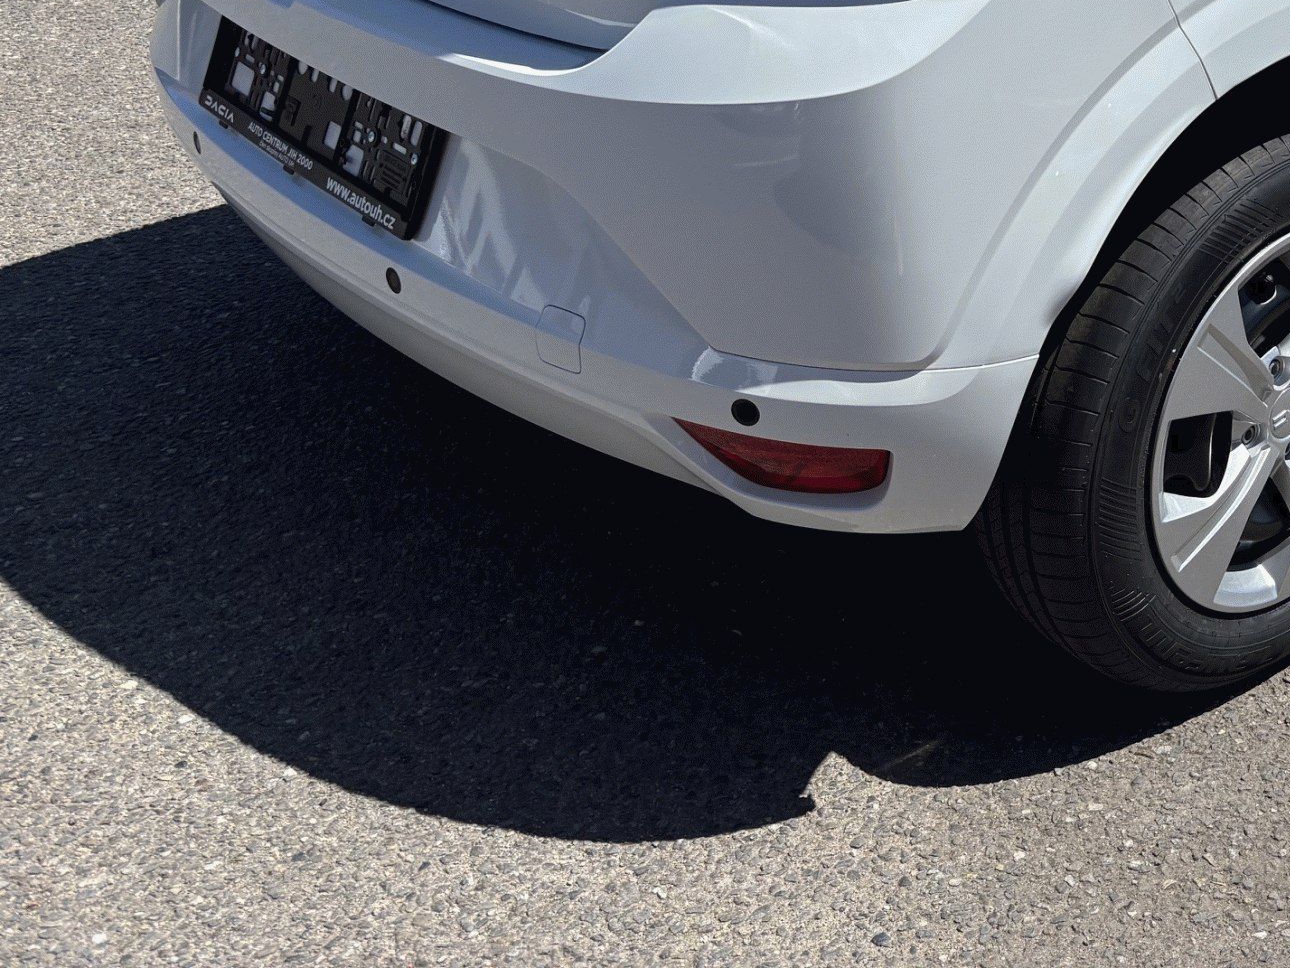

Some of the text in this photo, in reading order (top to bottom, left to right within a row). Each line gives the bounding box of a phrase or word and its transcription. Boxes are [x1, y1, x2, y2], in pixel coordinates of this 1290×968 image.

[204, 95, 234, 123] DACIA
[248, 121, 263, 137] AUTO
[262, 131, 288, 154] CENTRUM
[296, 153, 314, 170] 2000
[325, 176, 396, 229] www.autouh.cz
